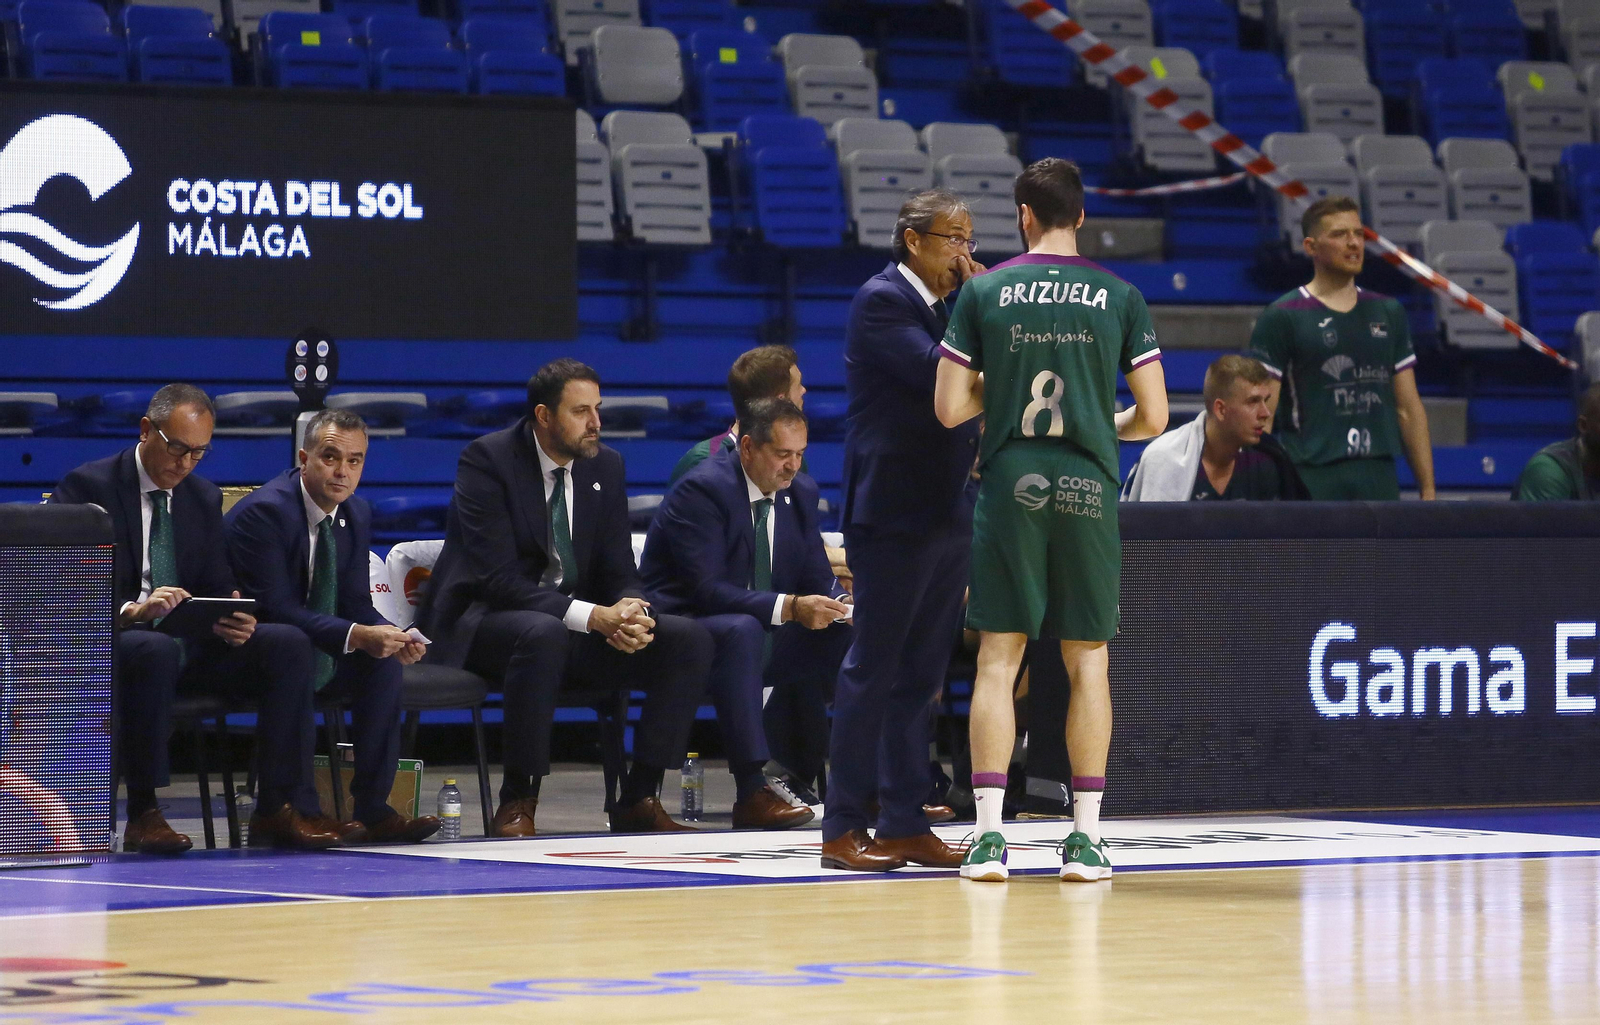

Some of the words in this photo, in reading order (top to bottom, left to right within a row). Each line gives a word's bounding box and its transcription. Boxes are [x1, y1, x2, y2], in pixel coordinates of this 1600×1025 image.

[167, 178, 278, 216] COSTA
[286, 180, 350, 217] DEL
[357, 183, 424, 220] SOL
[167, 217, 311, 258] MÁLAGA
[999, 281, 1108, 310] BRIZUELA
[1021, 370, 1064, 437] 8
[1347, 427, 1372, 454] 99
[1055, 490, 1082, 504] DEL
[1084, 493, 1103, 508] SOL
[1058, 475, 1103, 496] COSTA
[1054, 502, 1103, 520] MÁLAGA
[375, 583, 392, 593] SOL
[1308, 621, 1526, 718] Gama
[1555, 620, 1597, 714] E
